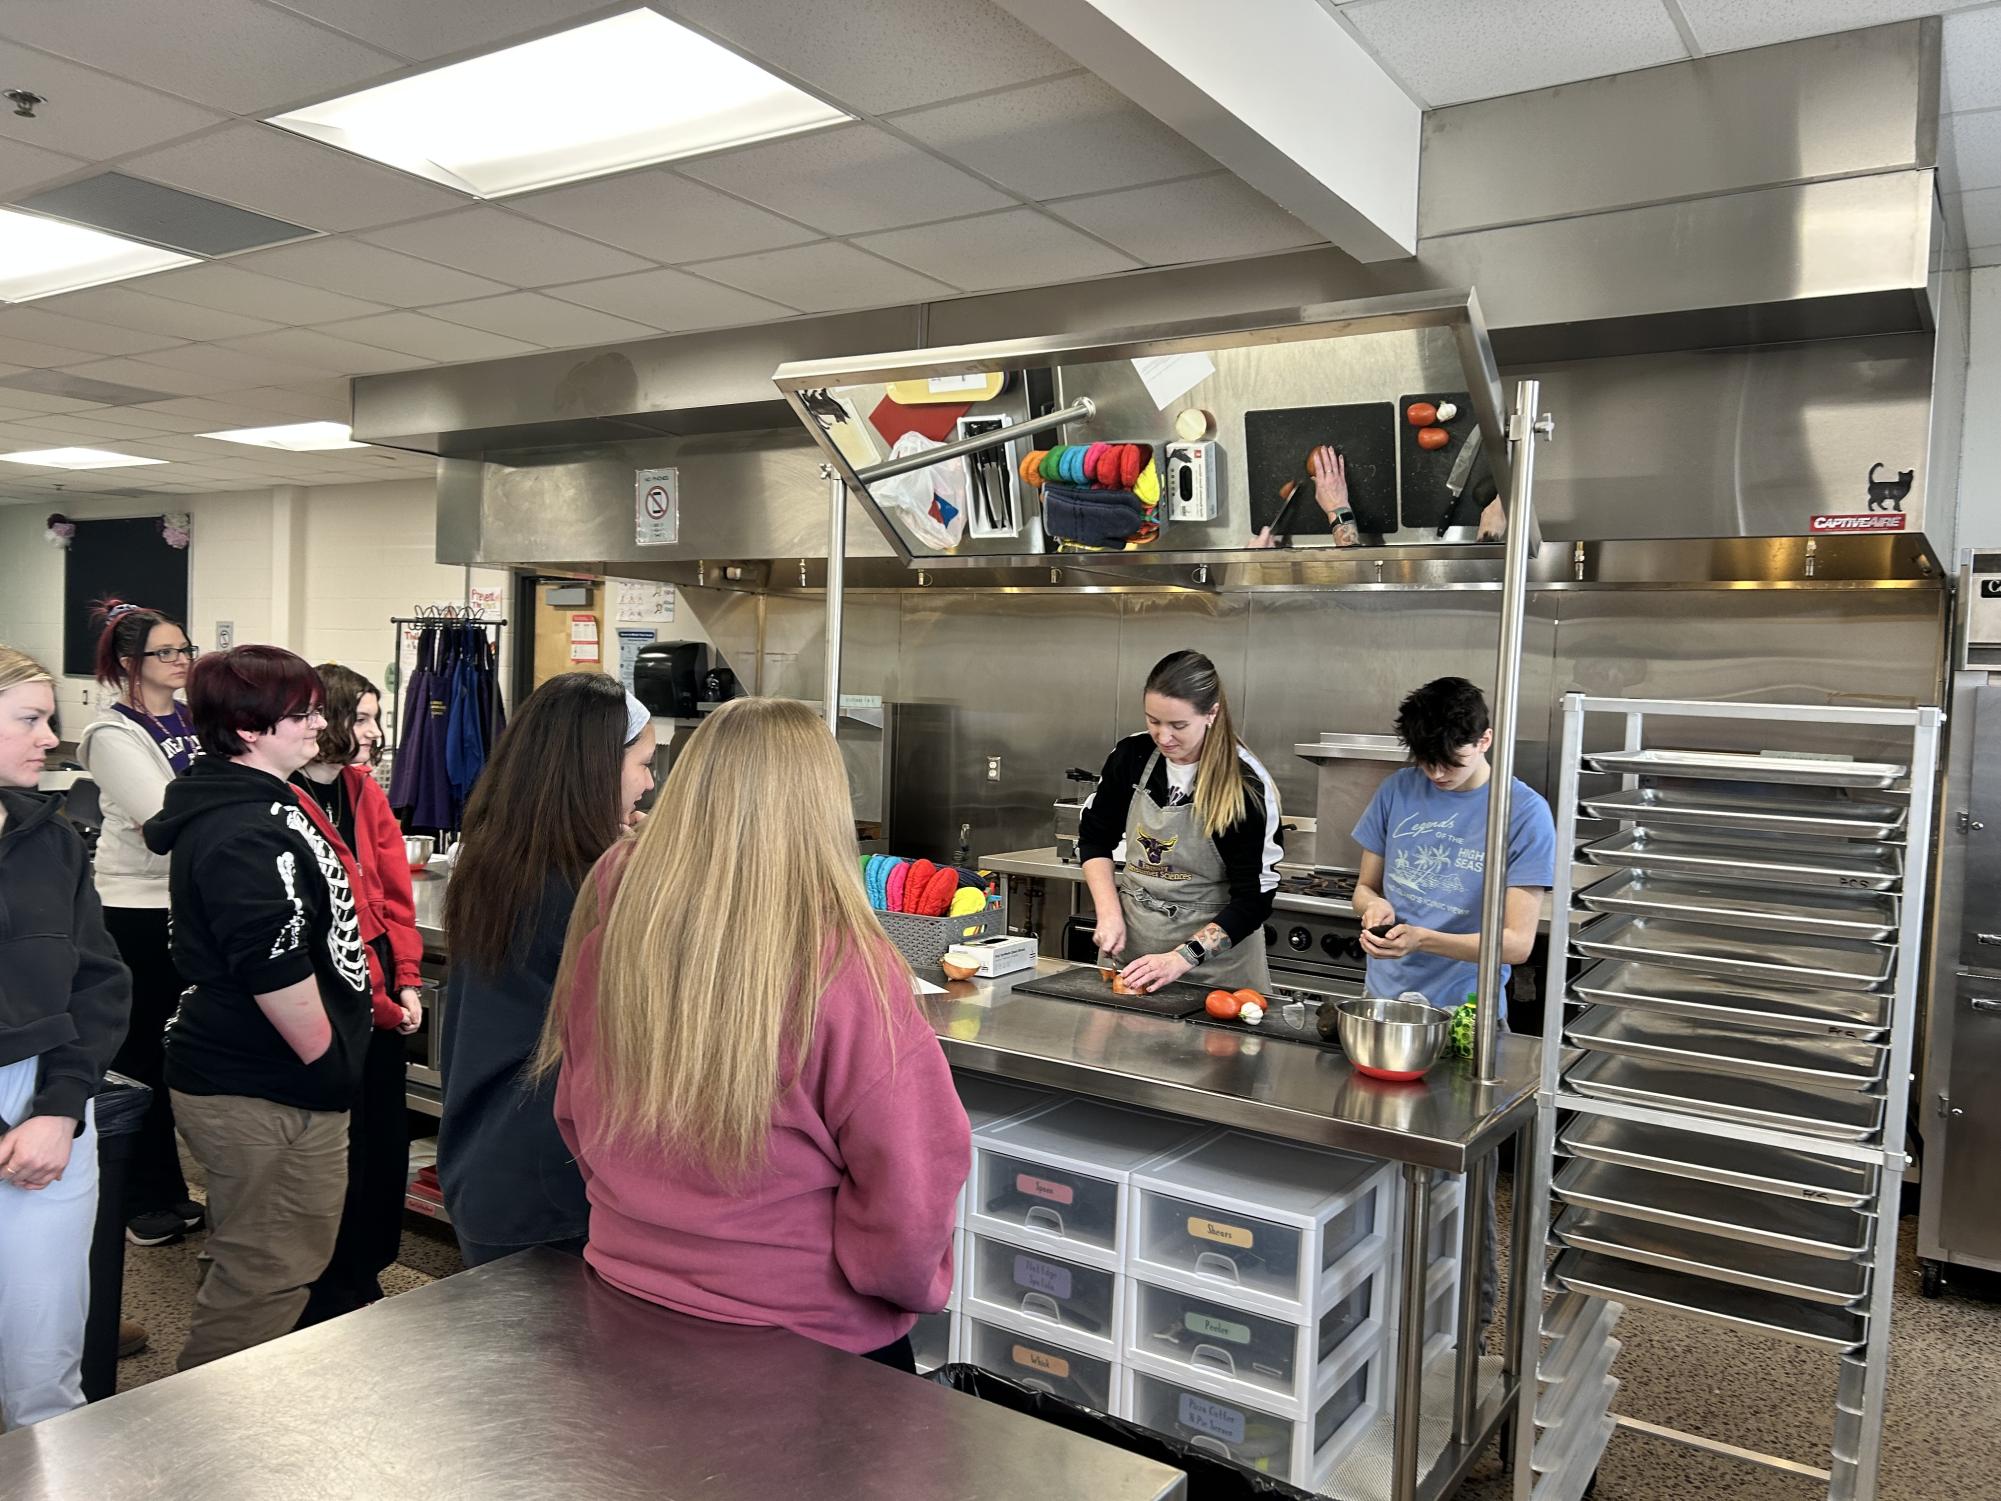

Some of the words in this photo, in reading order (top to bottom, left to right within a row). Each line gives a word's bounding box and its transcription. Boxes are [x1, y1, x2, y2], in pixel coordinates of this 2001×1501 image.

[1813, 516, 1902, 529] CAPTIVEAIRE
[1393, 812, 1459, 838] Legends
[1435, 831, 1447, 839] OF
[1447, 834, 1465, 845] THE
[1457, 847, 1485, 861] HIGH
[1454, 858, 1484, 873] SEAS
[1207, 1223, 1233, 1239] Shears
